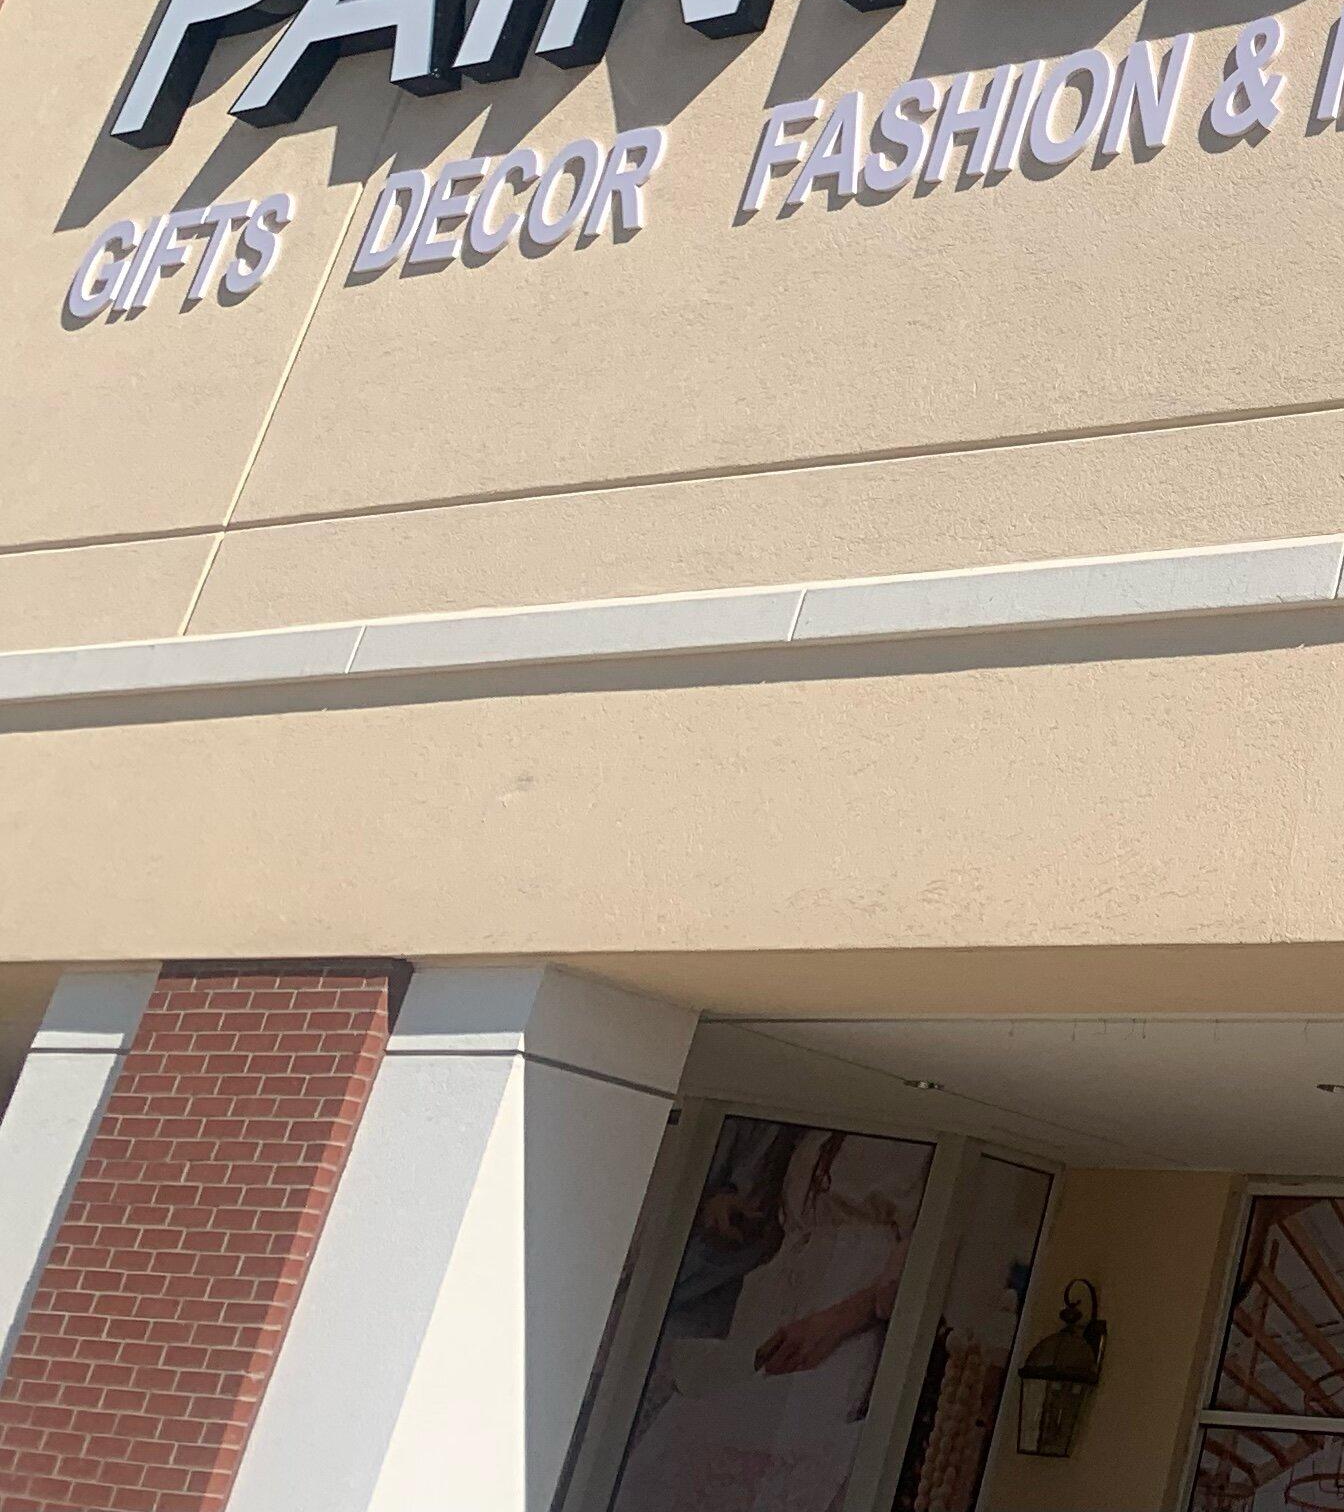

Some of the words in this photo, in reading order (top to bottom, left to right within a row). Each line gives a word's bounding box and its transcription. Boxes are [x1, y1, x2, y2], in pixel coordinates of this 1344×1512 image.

[68, 192, 296, 320] GIFTS
[353, 125, 667, 276] DECOR
[741, 32, 1193, 214] FASHION
[1209, 14, 1289, 139] &
